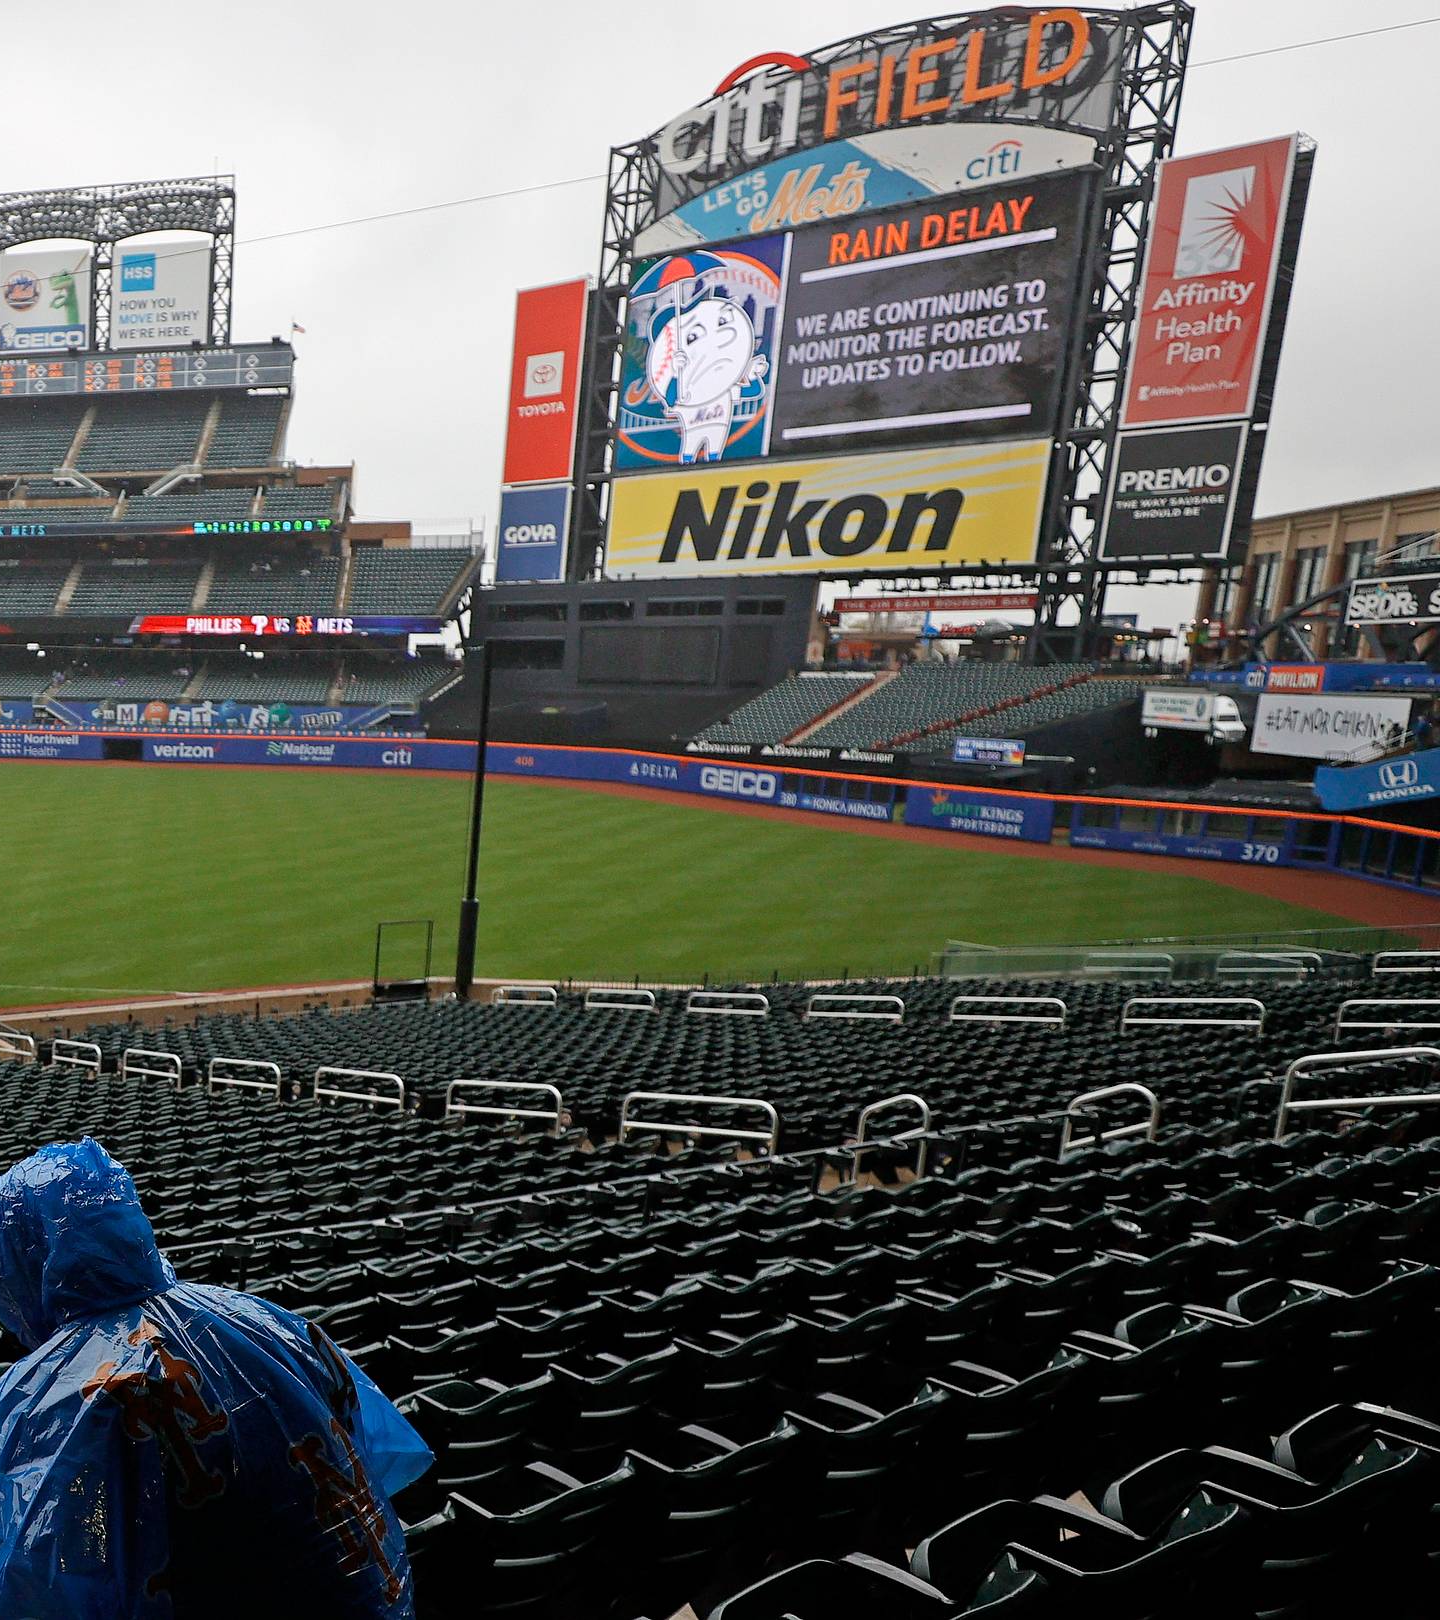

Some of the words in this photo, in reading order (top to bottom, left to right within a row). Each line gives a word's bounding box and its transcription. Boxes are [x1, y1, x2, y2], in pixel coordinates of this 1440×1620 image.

[660, 66, 804, 174] citi
[823, 9, 1090, 138] FIELD
[965, 146, 1021, 181] citi
[702, 170, 767, 213] LET'S
[750, 161, 870, 233] Mets
[736, 188, 770, 216] GO
[829, 219, 910, 265] RAIN
[920, 196, 1034, 249] DELAY
[124, 266, 153, 279] HSS
[120, 300, 147, 310] HOW
[151, 298, 176, 308] YOU
[1152, 279, 1256, 311] Affinity
[795, 314, 827, 337] WE
[830, 308, 870, 334] ARE
[873, 286, 1008, 326] CONTINUING
[1013, 278, 1047, 305] TO
[119, 313, 154, 324] MOVE
[156, 312, 168, 321] IS
[171, 310, 199, 321] WHY
[1155, 309, 1243, 341] Health
[14, 330, 83, 348] GEICO
[119, 327, 155, 339] WE'RE
[158, 325, 192, 337] HERE.
[787, 331, 881, 366] MONITOR
[886, 324, 927, 350] THE
[930, 308, 1049, 346] FORECAST.
[137, 351, 187, 359] NATIONAL
[1166, 341, 1221, 365] Plan
[802, 356, 891, 390] UPDATES
[896, 351, 922, 377] TO
[927, 340, 1023, 373] FOLLOW.
[517, 401, 565, 418] TOYOTA
[1118, 464, 1230, 493] PREMIO
[1116, 500, 1138, 509] THE
[1140, 498, 1167, 508] WAY
[1169, 495, 1225, 506] SAUSAGE
[657, 479, 966, 565] Nikon
[1133, 508, 1181, 520] SHOULD
[1183, 507, 1200, 516] BE
[11, 525, 48, 537] METS
[504, 524, 557, 543] GOYA
[186, 618, 242, 633] PHILLIES
[273, 618, 289, 633] VS
[317, 618, 353, 634] METS
[1269, 673, 1318, 688] PAVILION
[1266, 706, 1300, 733] #EAT
[1300, 708, 1330, 736] MOR
[24, 734, 79, 744] Northwell
[24, 745, 58, 756] Health
[153, 742, 214, 758] verizon
[282, 743, 335, 756] National
[382, 747, 412, 765] citi
[641, 763, 678, 780] DELTA
[700, 766, 776, 799] GEICO
[781, 792, 797, 806] 380
[1368, 783, 1435, 801] HONDA
[813, 797, 847, 814] KONICA
[848, 802, 888, 819] MINOLTA
[951, 817, 1021, 836] SPORTSBOOK
[1241, 843, 1278, 863] 370
